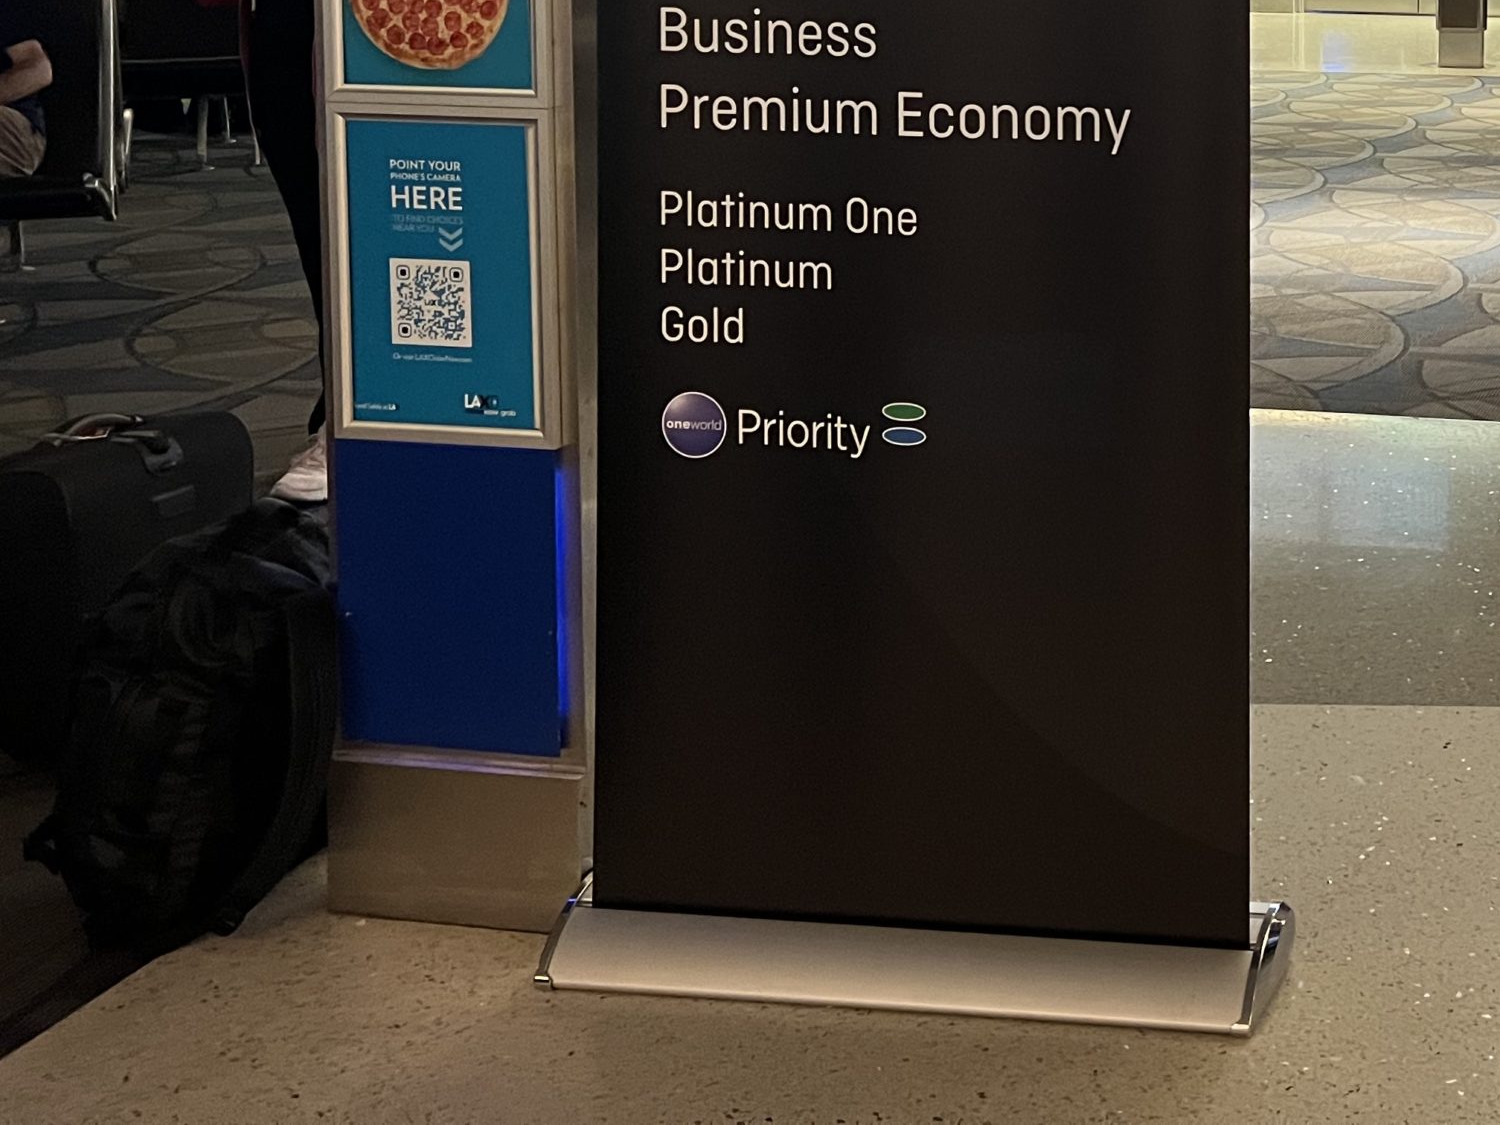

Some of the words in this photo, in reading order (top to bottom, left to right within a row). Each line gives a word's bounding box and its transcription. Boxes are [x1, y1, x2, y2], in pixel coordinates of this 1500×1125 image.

[659, 6, 878, 58] Business
[659, 83, 878, 136] Premium
[898, 91, 1132, 156] Economy
[390, 159, 426, 170] POINT
[428, 160, 461, 172] YOUR
[390, 172, 425, 181] PHONE'S
[427, 173, 461, 182] CAMERA
[391, 185, 463, 211] HERE
[660, 189, 833, 232] Platinum
[845, 196, 918, 237] One
[660, 247, 833, 290] Platinum
[660, 305, 744, 344] Gold
[665, 417, 722, 432] oneworld
[737, 408, 871, 459] Priority
